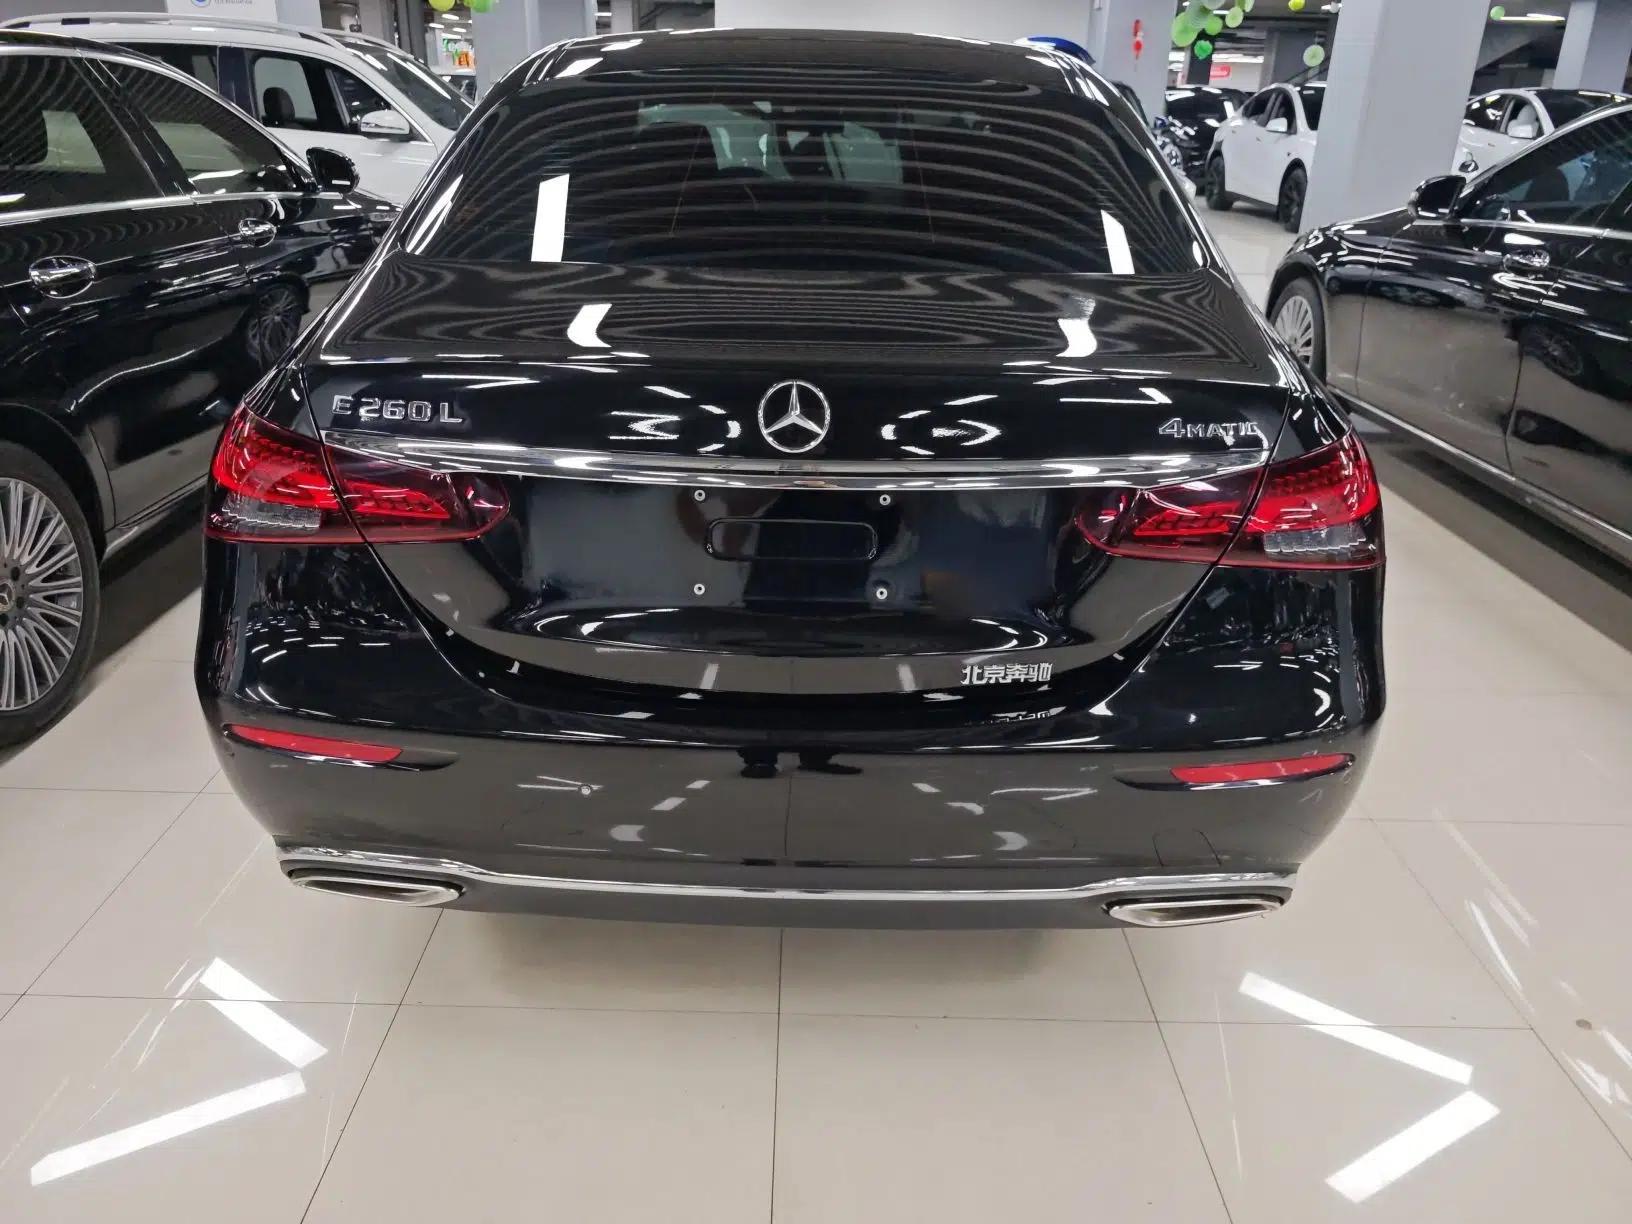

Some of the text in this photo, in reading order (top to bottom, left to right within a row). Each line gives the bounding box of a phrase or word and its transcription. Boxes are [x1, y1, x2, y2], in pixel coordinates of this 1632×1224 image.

[332, 394, 463, 423] E 260 L
[960, 662, 1053, 685] 北京奔驰
